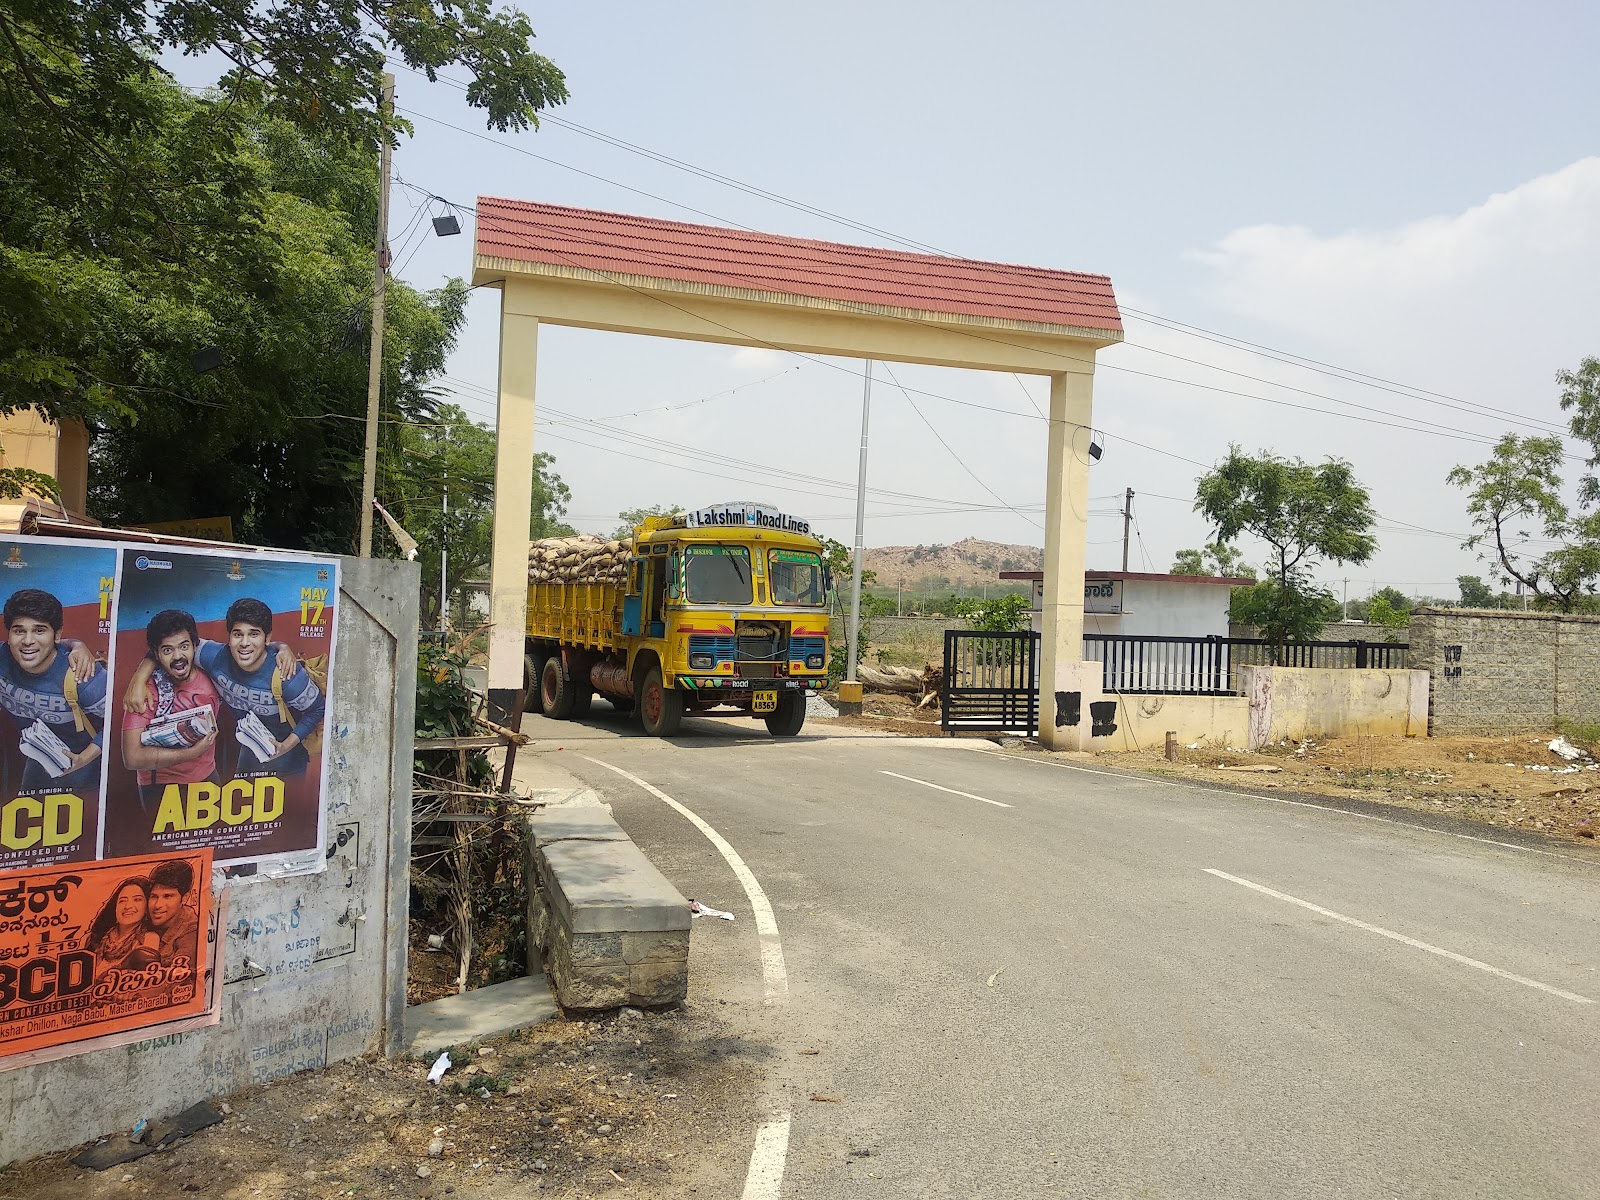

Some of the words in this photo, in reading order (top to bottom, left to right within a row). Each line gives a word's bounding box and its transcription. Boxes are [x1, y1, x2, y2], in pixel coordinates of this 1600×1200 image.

[697, 509, 745, 526] Lakshmi
[756, 509, 781, 529] Road
[782, 514, 809, 534] Lines
[301, 587, 328, 601] MAY
[300, 625, 324, 633] GRAND
[217, 674, 274, 705] SUPER
[766, 693, 773, 701] 16
[38, 787, 62, 795] SIRISH
[152, 776, 285, 834] ABCD
[152, 831, 190, 841] AMERICAN
[193, 829, 213, 837] BORN
[217, 824, 259, 834] CONFUSED
[57, 844, 80, 853] DESI
[14, 1001, 62, 1018] CONFUSED
[67, 996, 89, 1008] DESI
[26, 1016, 59, 1033] Dhillon,
[60, 1012, 83, 1027] Naga
[83, 1006, 107, 1021] Babu,
[109, 1002, 136, 1016] Master
[137, 994, 168, 1010] Bharath
